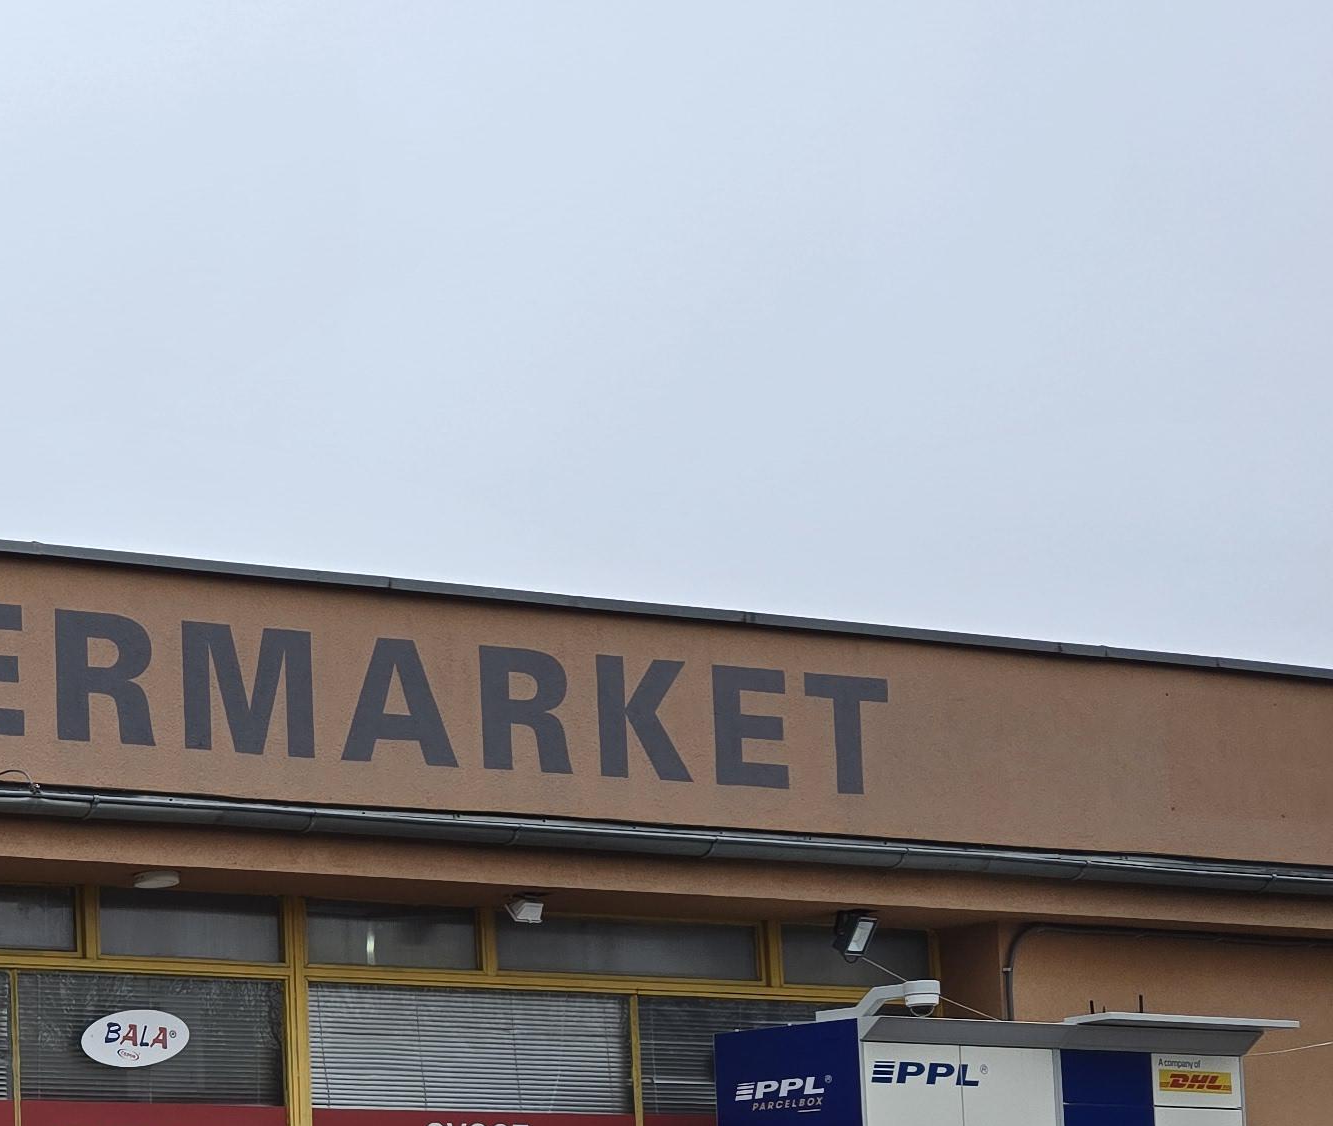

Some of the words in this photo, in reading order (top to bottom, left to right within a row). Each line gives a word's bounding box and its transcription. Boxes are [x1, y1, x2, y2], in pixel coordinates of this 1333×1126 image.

[1158, 1058, 1163, 1066] A
[1165, 1060, 1193, 1069] company
[1194, 1060, 1201, 1068] of
[1169, 1073, 1222, 1090] DHL
[752, 1097, 823, 1111] PARCELBOX
